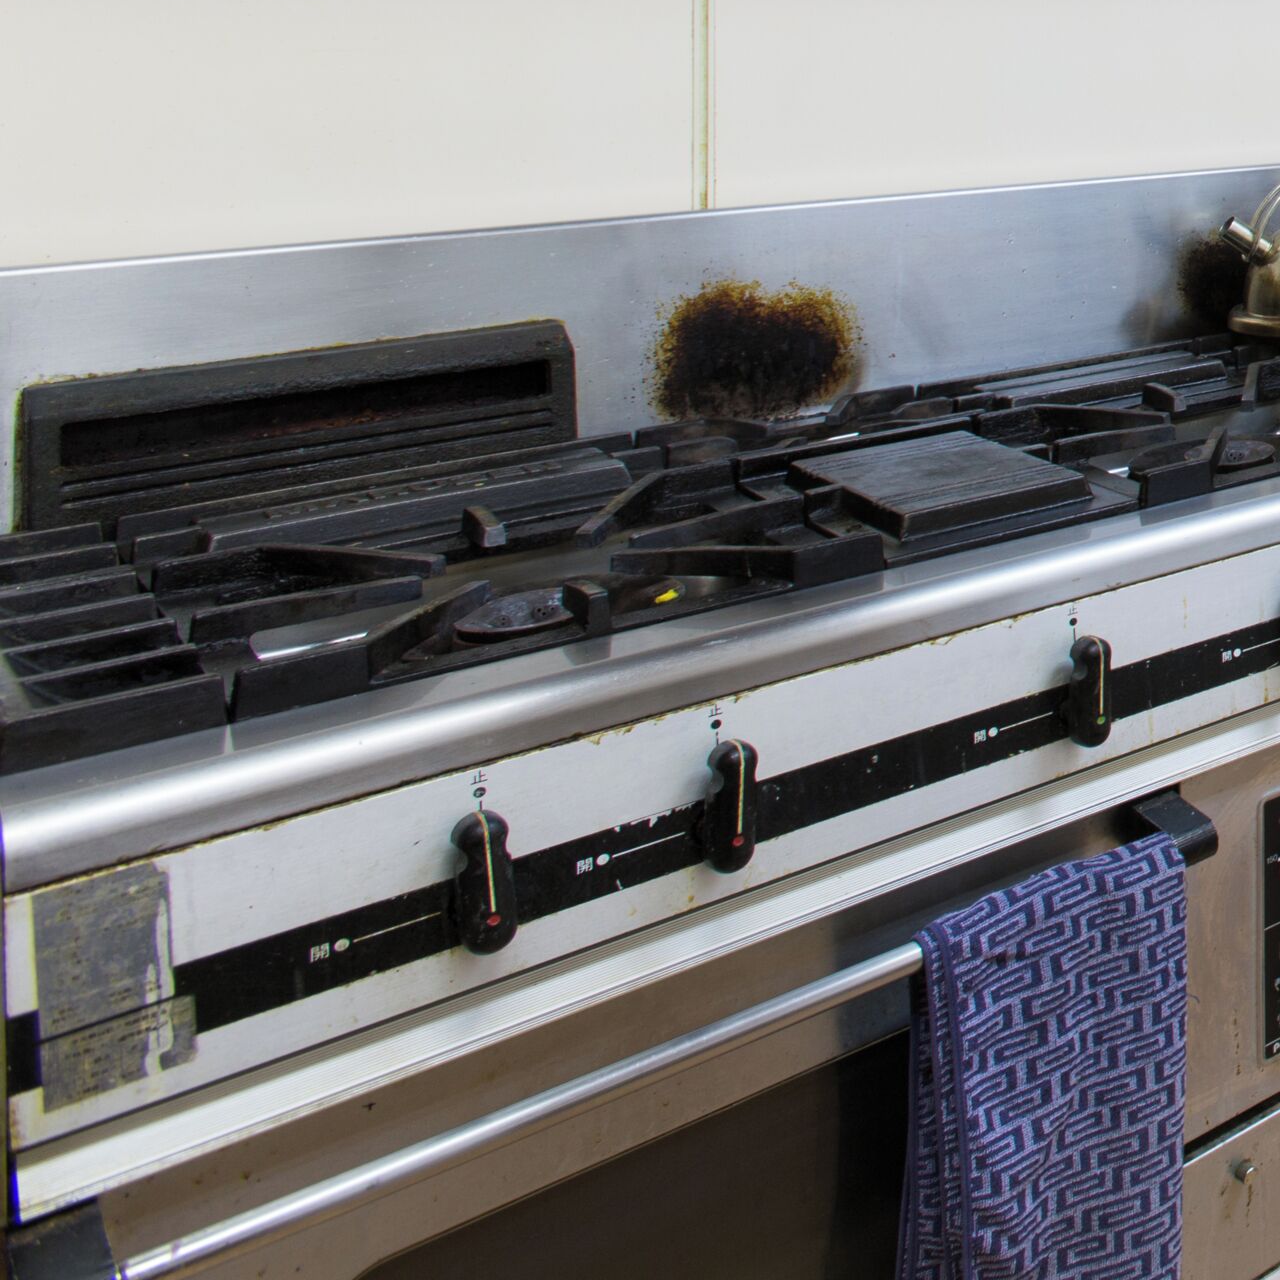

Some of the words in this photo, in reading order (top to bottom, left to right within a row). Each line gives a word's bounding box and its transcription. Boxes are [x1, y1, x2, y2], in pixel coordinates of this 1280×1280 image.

[1067, 603, 1078, 616] 止
[708, 704, 723, 718] 止
[974, 729, 987, 745] 開
[470, 770, 488, 786] 止
[576, 856, 593, 875] 開
[310, 942, 330, 963] 開
